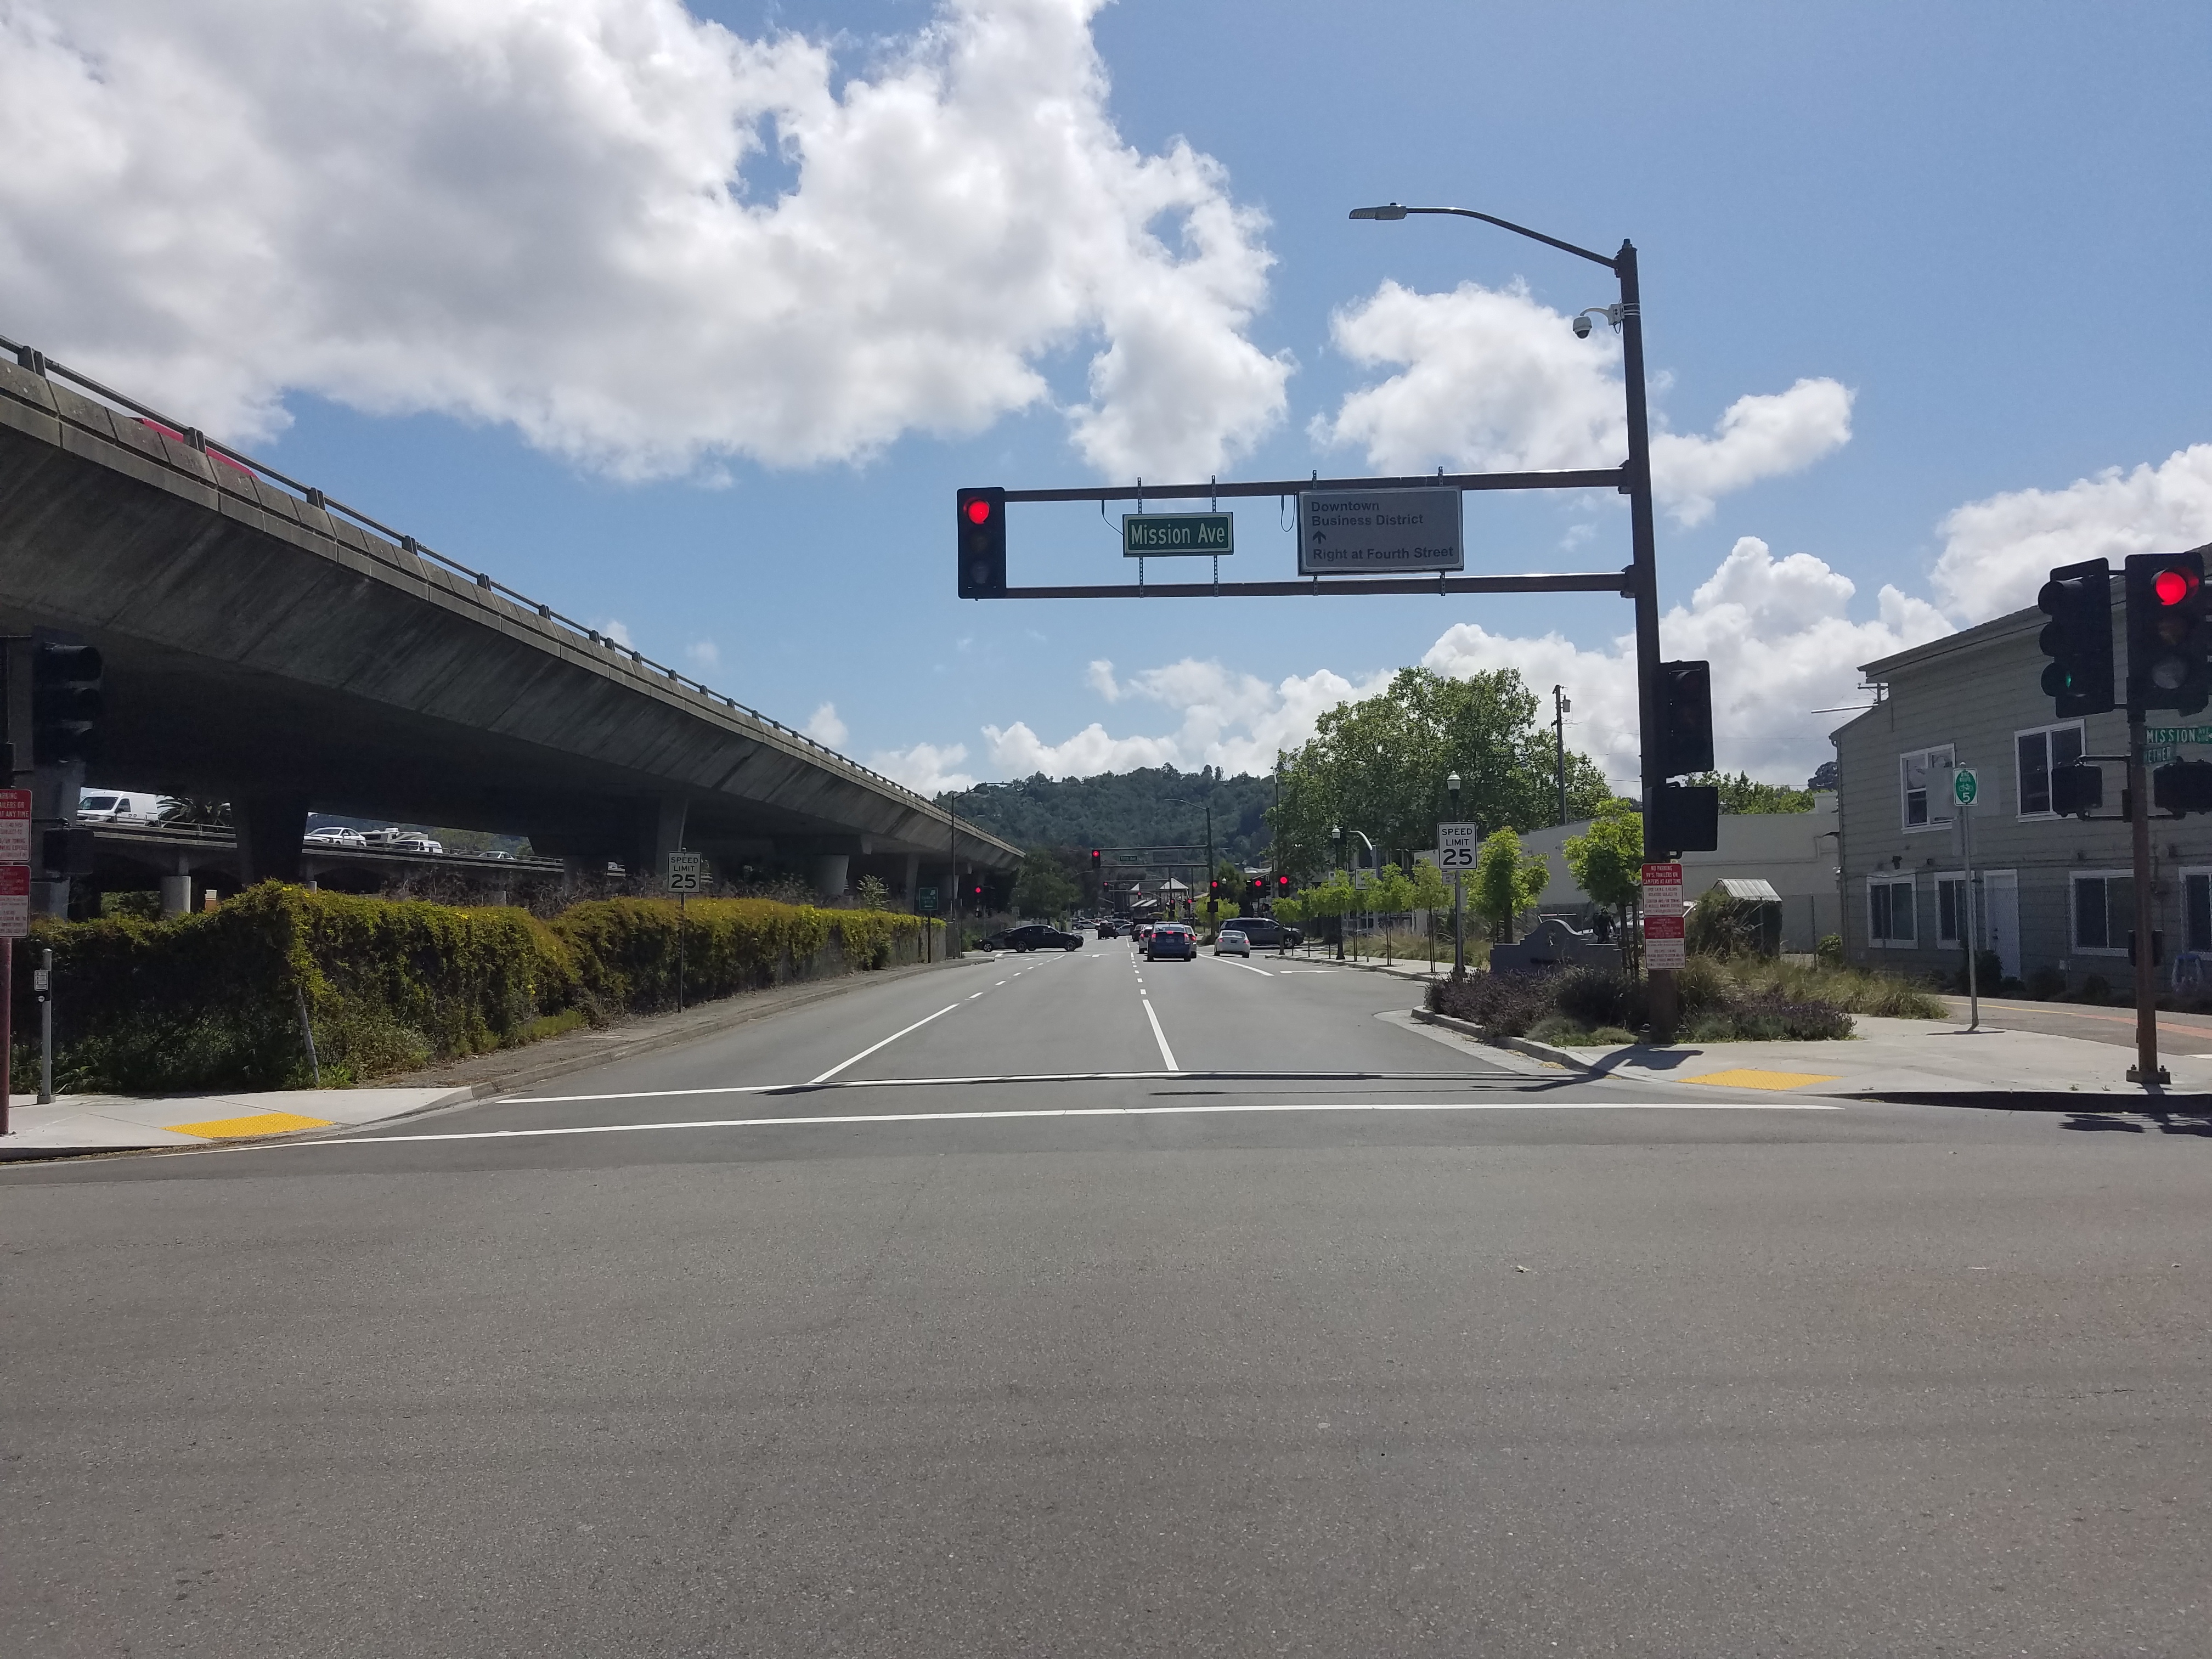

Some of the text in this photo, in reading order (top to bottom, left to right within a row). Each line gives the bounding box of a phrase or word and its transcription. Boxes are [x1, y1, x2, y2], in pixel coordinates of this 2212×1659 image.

[1311, 501, 1380, 512] Downtown
[1312, 514, 1424, 526] Business District
[1131, 523, 1225, 545] Mission Ave
[1313, 546, 1453, 562] Right at Fourth Street
[2147, 729, 2195, 743] MISSION
[1962, 792, 1971, 803] 5
[1443, 849, 1472, 865] 25
[671, 874, 696, 889] 25
